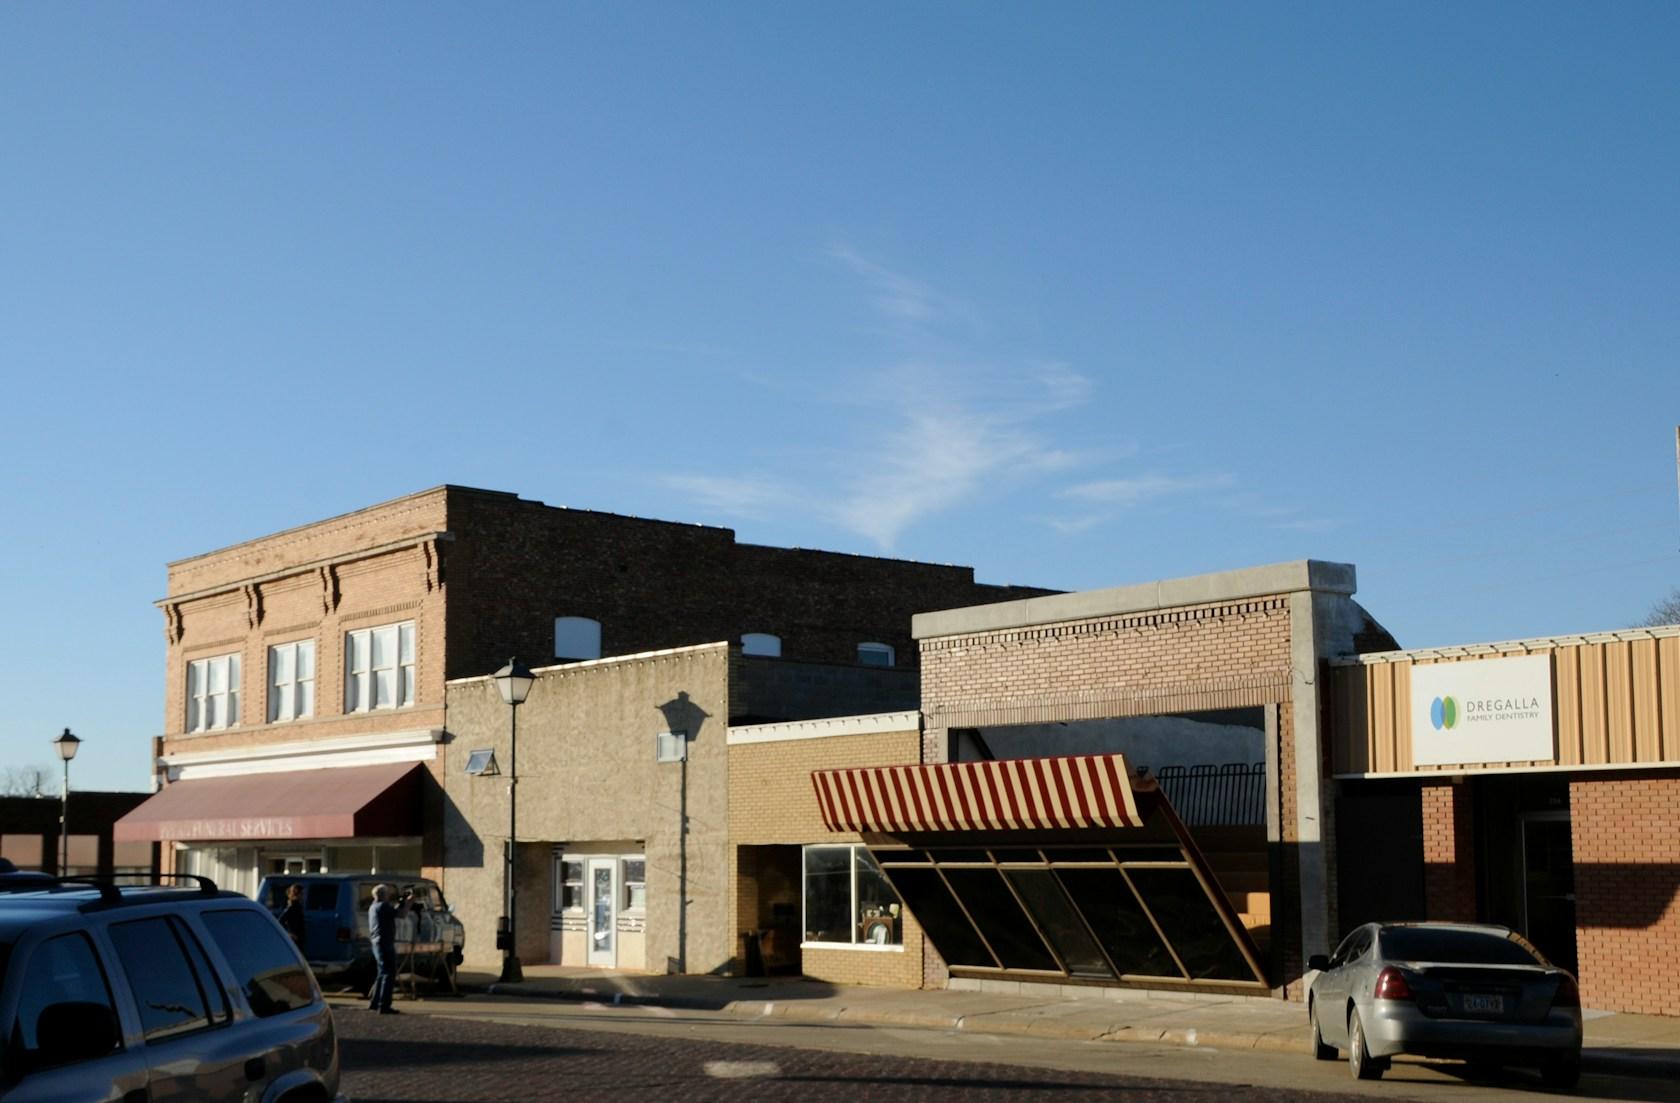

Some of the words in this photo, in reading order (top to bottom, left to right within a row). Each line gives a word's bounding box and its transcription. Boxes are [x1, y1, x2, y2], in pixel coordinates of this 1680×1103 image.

[1466, 697, 1540, 713] DREGALLA
[1495, 711, 1540, 721] DENTISTRY
[240, 818, 294, 836] SERVICES
